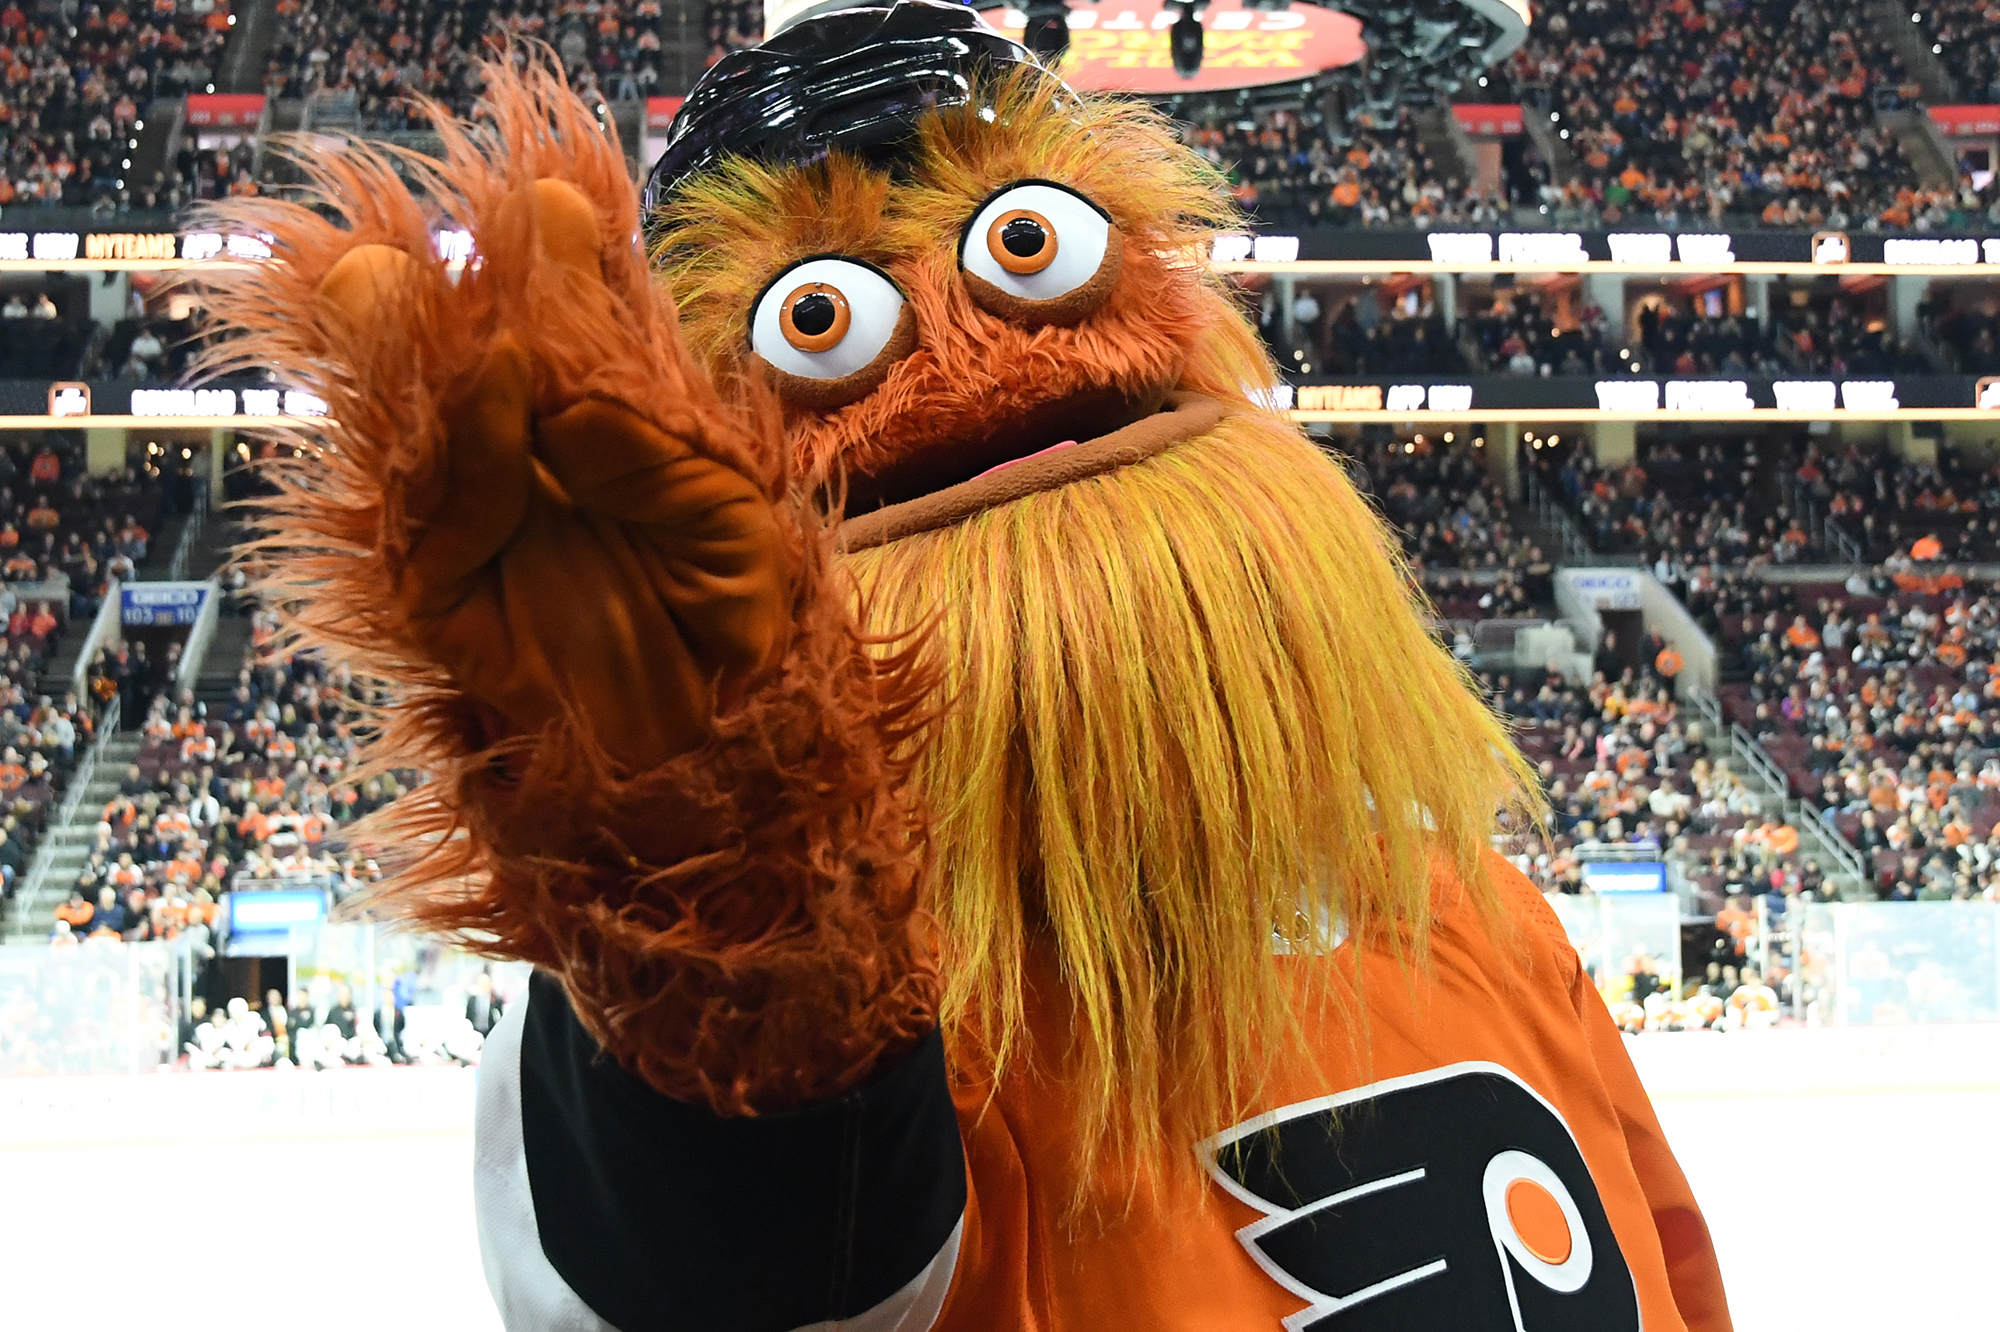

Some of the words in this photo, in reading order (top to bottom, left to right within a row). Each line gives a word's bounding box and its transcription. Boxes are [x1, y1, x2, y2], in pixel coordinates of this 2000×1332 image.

[86, 234, 175, 259] MYTEAMS
[1298, 386, 1382, 410] MYTEAMS
[131, 588, 199, 605] GEICO
